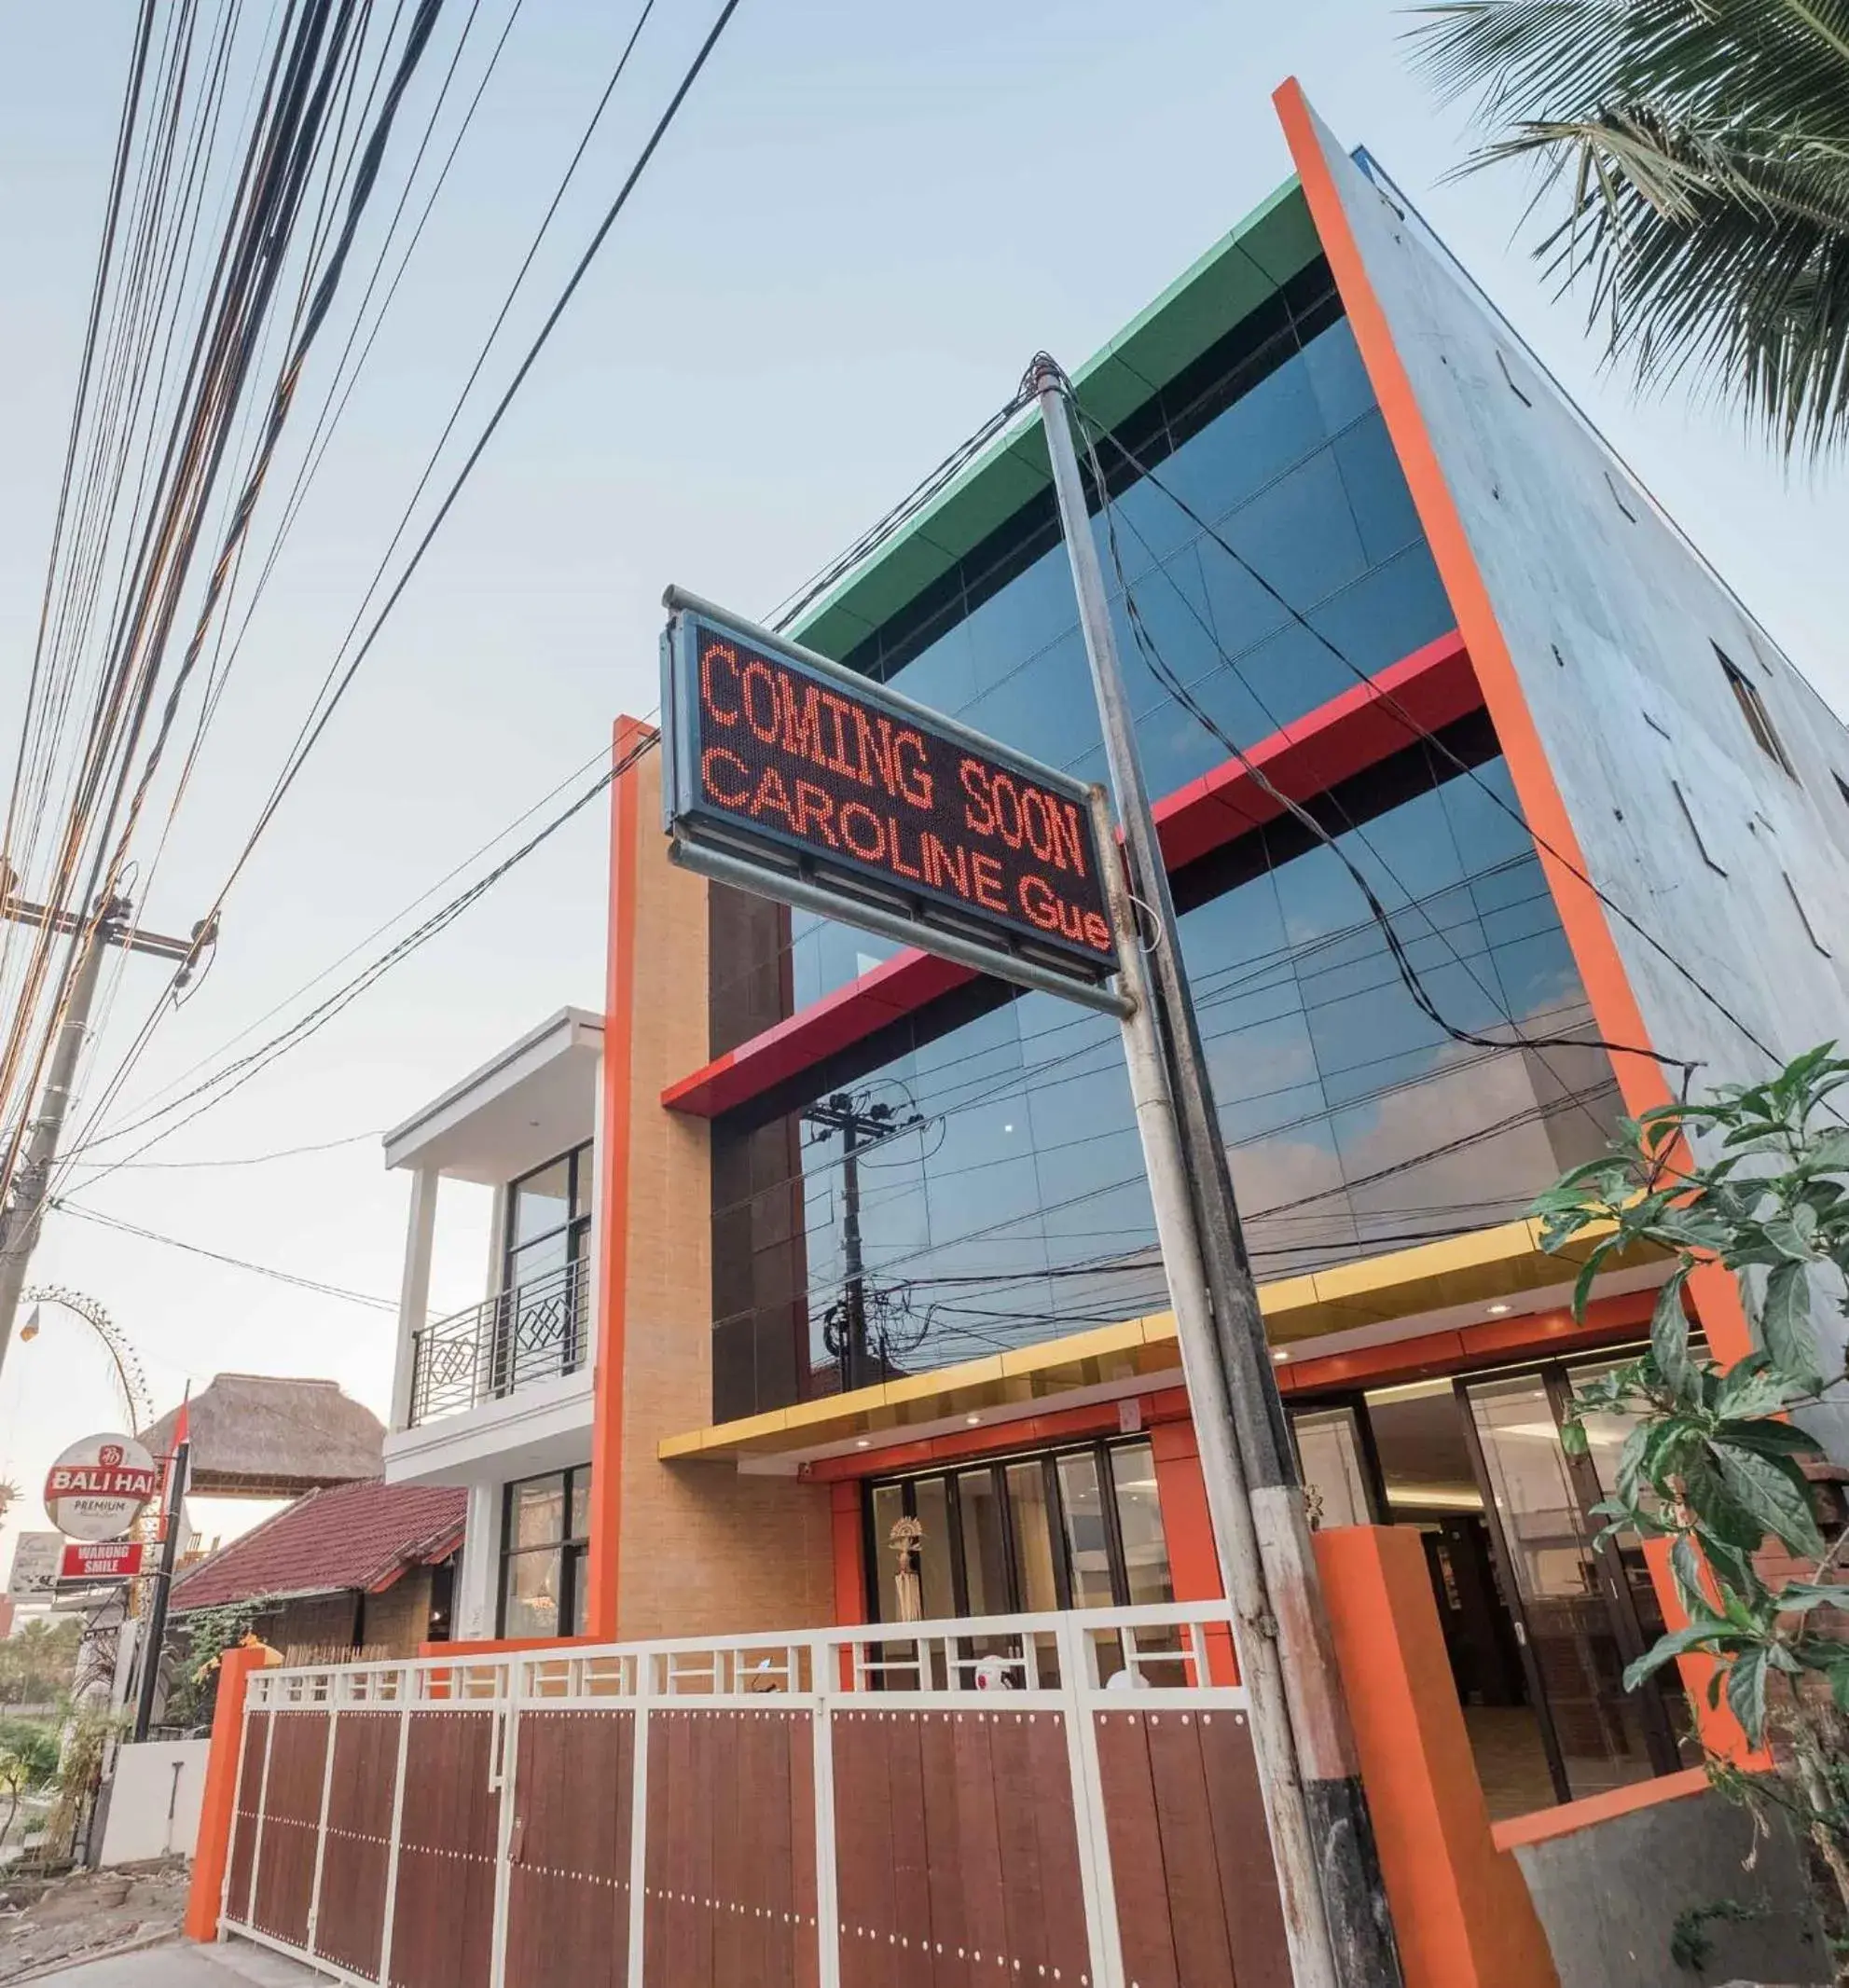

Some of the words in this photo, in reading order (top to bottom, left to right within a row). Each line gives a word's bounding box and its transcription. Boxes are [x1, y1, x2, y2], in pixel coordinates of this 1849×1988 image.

[700, 643, 933, 809] COMING
[959, 757, 1086, 877] SOON
[701, 747, 1008, 913] CAROLINE
[1019, 874, 1111, 952] Gue
[51, 1470, 111, 1492] BALI
[114, 1473, 154, 1494] HAI
[74, 1499, 127, 1512] PREMIUM
[77, 1544, 131, 1559] WARUNG
[84, 1559, 119, 1574] SMILE
